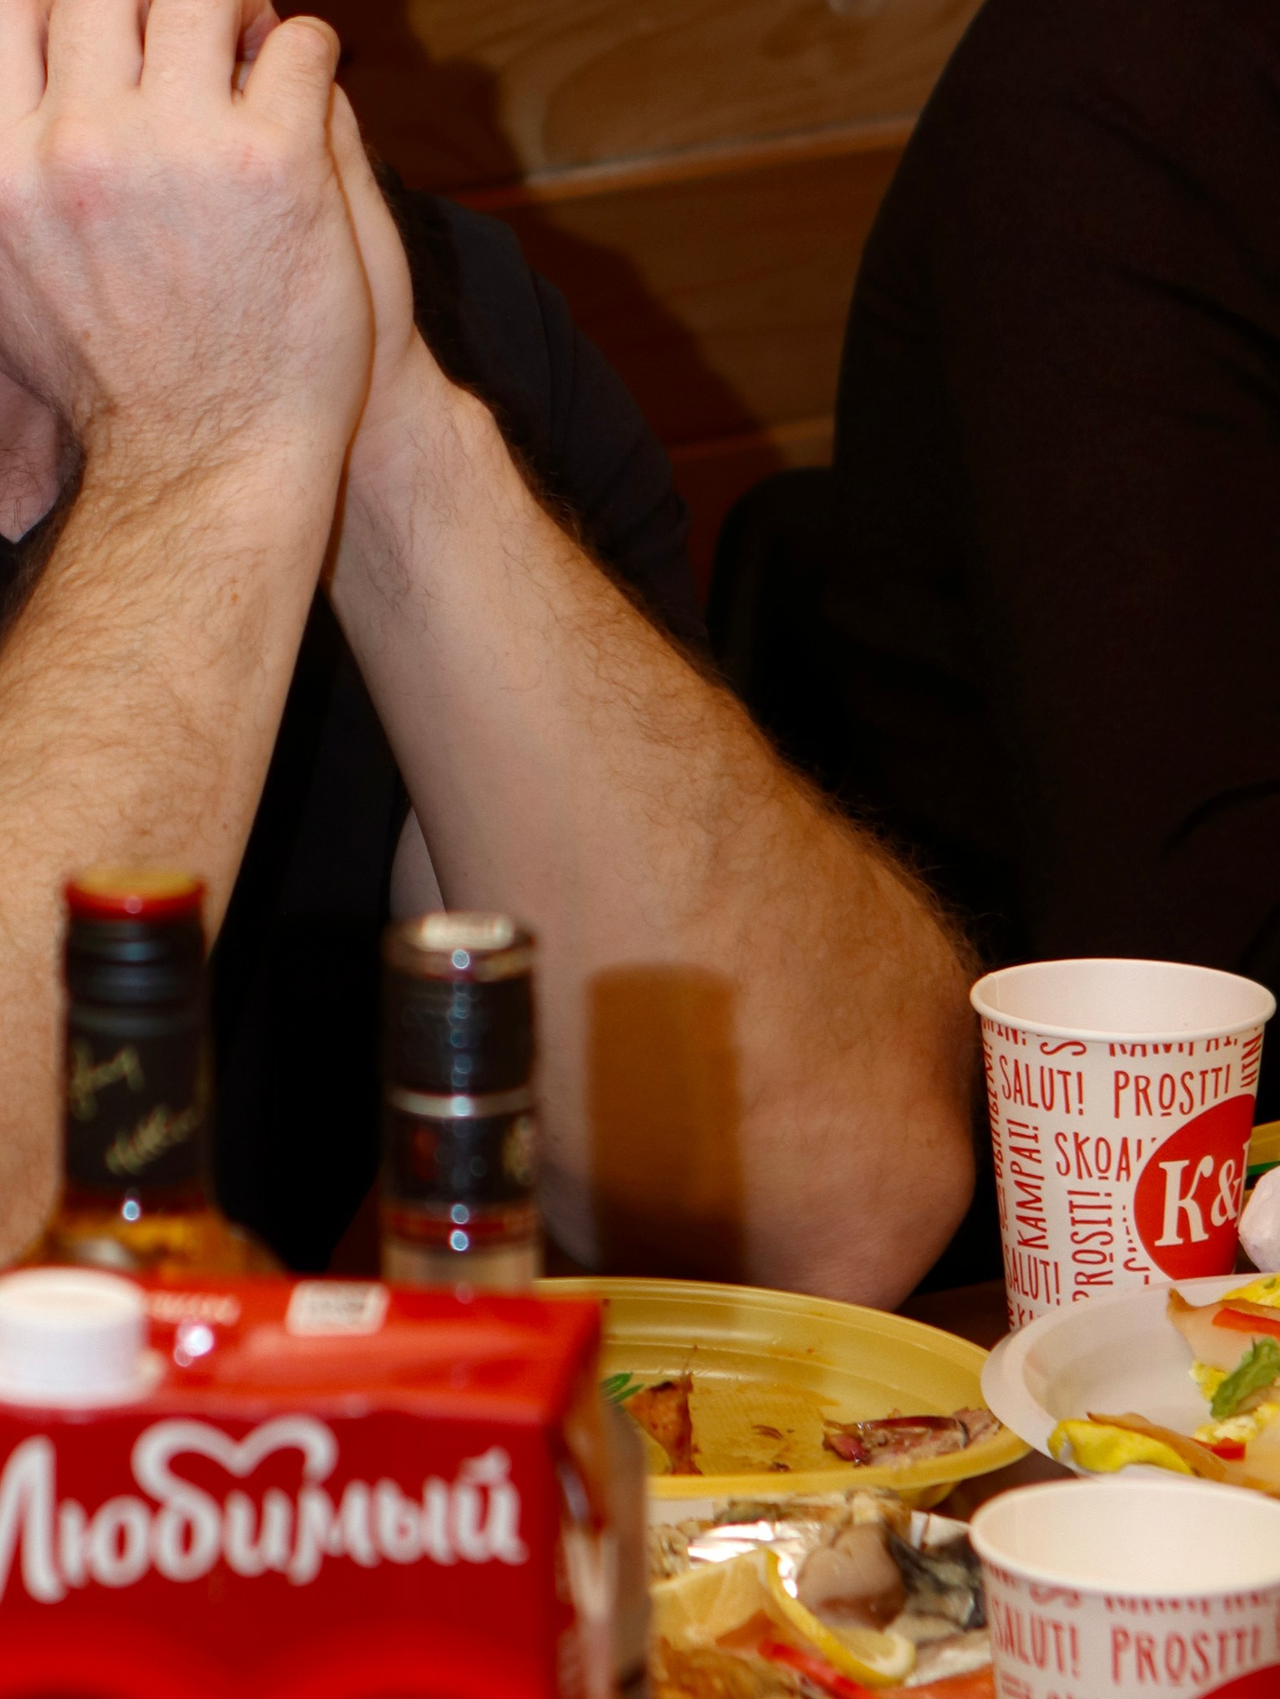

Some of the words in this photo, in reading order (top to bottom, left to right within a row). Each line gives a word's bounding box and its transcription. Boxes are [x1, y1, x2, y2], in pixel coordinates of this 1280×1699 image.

[998, 1054, 1084, 1117] SALUT!
[1006, 1118, 1050, 1251] KAMPAI!
[1154, 1139, 1249, 1247] K&
[1004, 1243, 1061, 1306] SALUT!
[991, 1596, 1080, 1679] SALUT!
